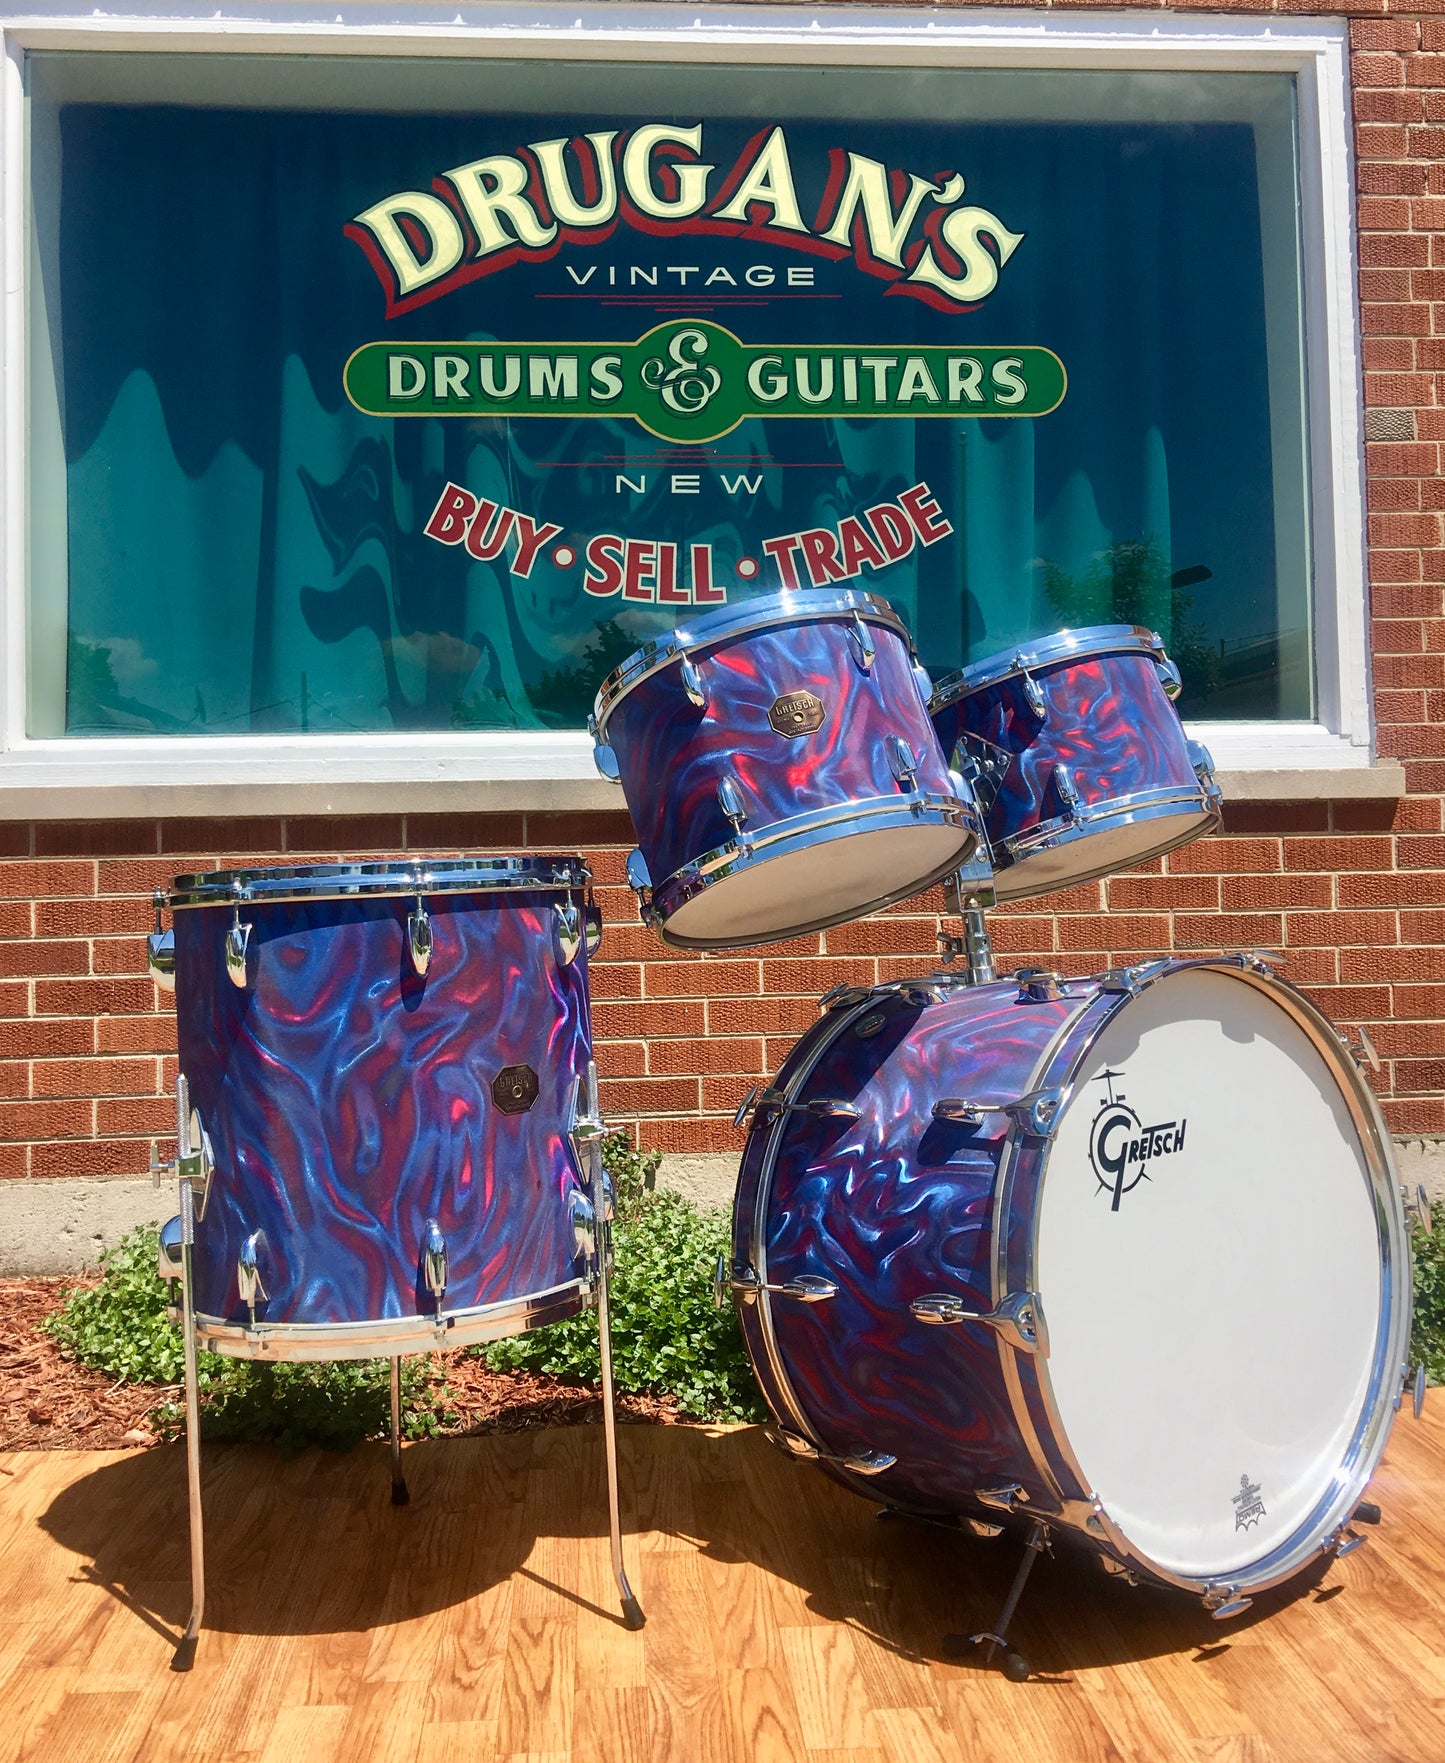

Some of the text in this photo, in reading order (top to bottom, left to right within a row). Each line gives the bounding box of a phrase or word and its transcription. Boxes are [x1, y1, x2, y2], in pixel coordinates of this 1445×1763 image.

[351, 122, 1025, 306] DRUGAN'S
[565, 265, 815, 287] VINTAGE
[387, 327, 1029, 416] DRUMS & GUITARS
[615, 474, 764, 495] NEW
[422, 481, 955, 606] BUY SELL TRADE
[776, 698, 815, 716] GRETSCH
[1238, 1504, 1262, 1523] REMO
